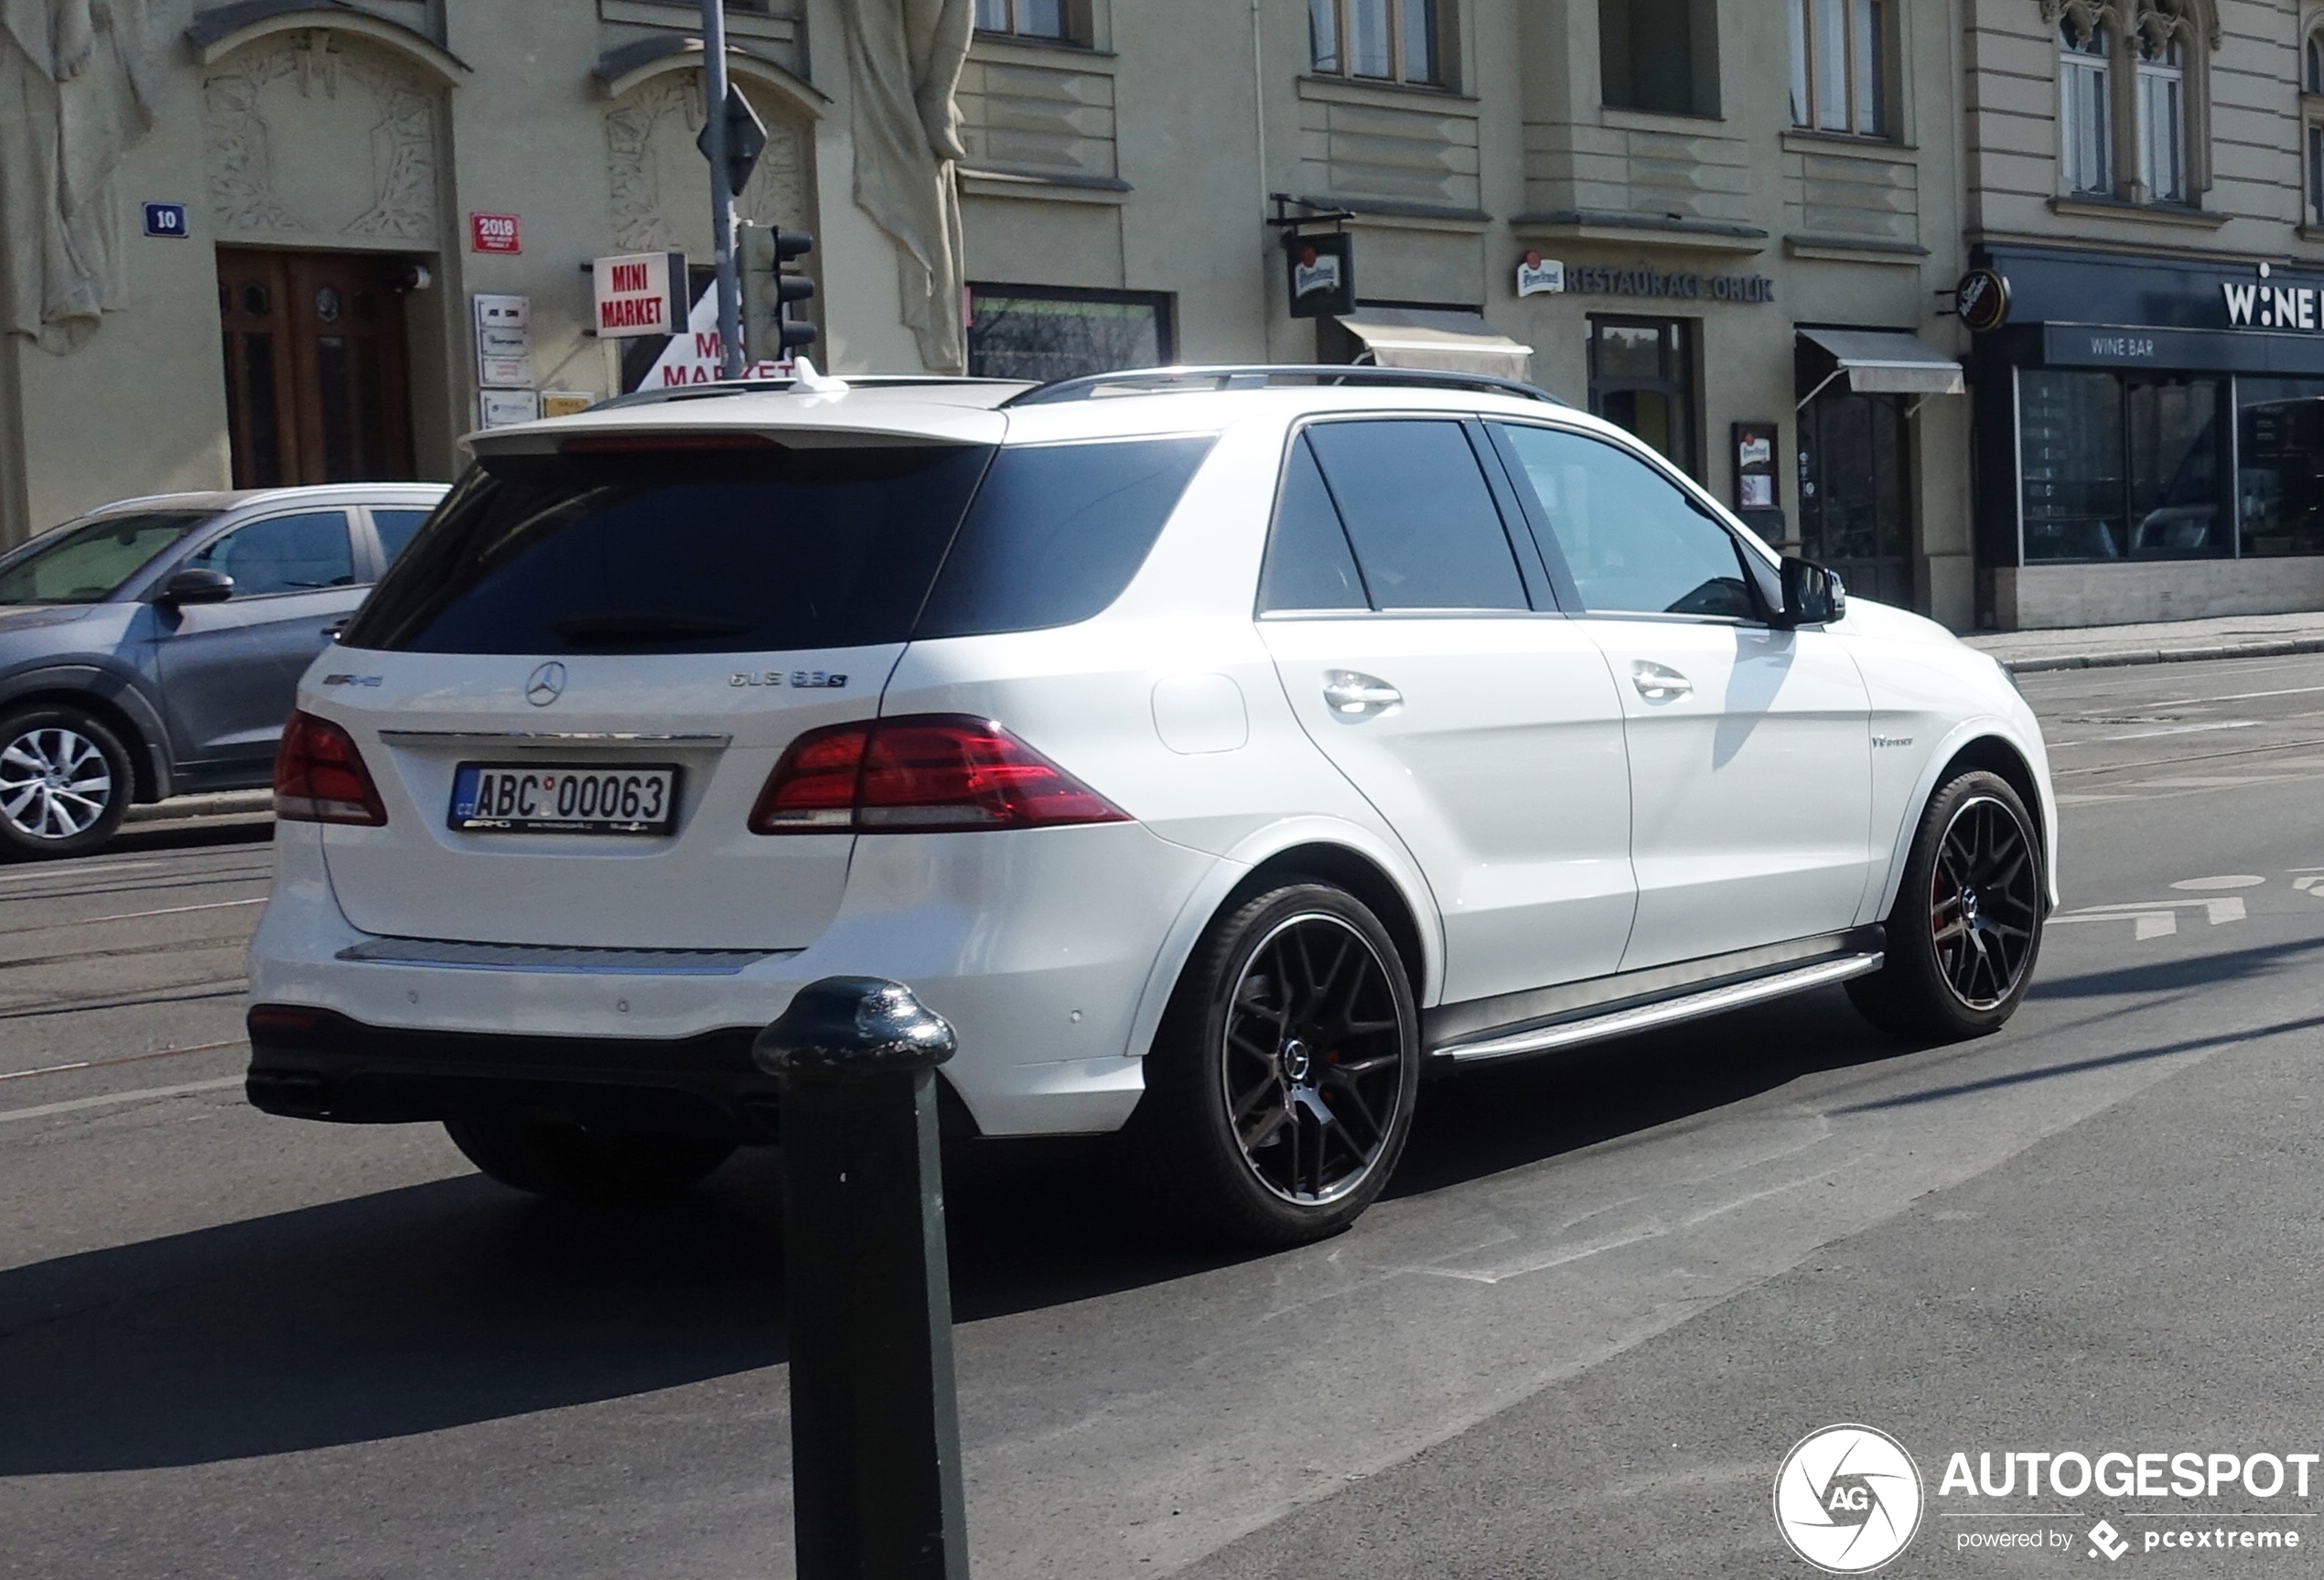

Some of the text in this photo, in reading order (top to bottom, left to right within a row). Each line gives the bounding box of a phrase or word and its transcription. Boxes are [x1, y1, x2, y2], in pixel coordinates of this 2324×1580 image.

[157, 210, 177, 228] 10
[479, 218, 514, 236] 2018
[612, 263, 647, 292] MINI
[601, 296, 662, 328] MARKET
[2091, 338, 2154, 357] WINE BAR
[476, 774, 663, 819] ABC 00063
